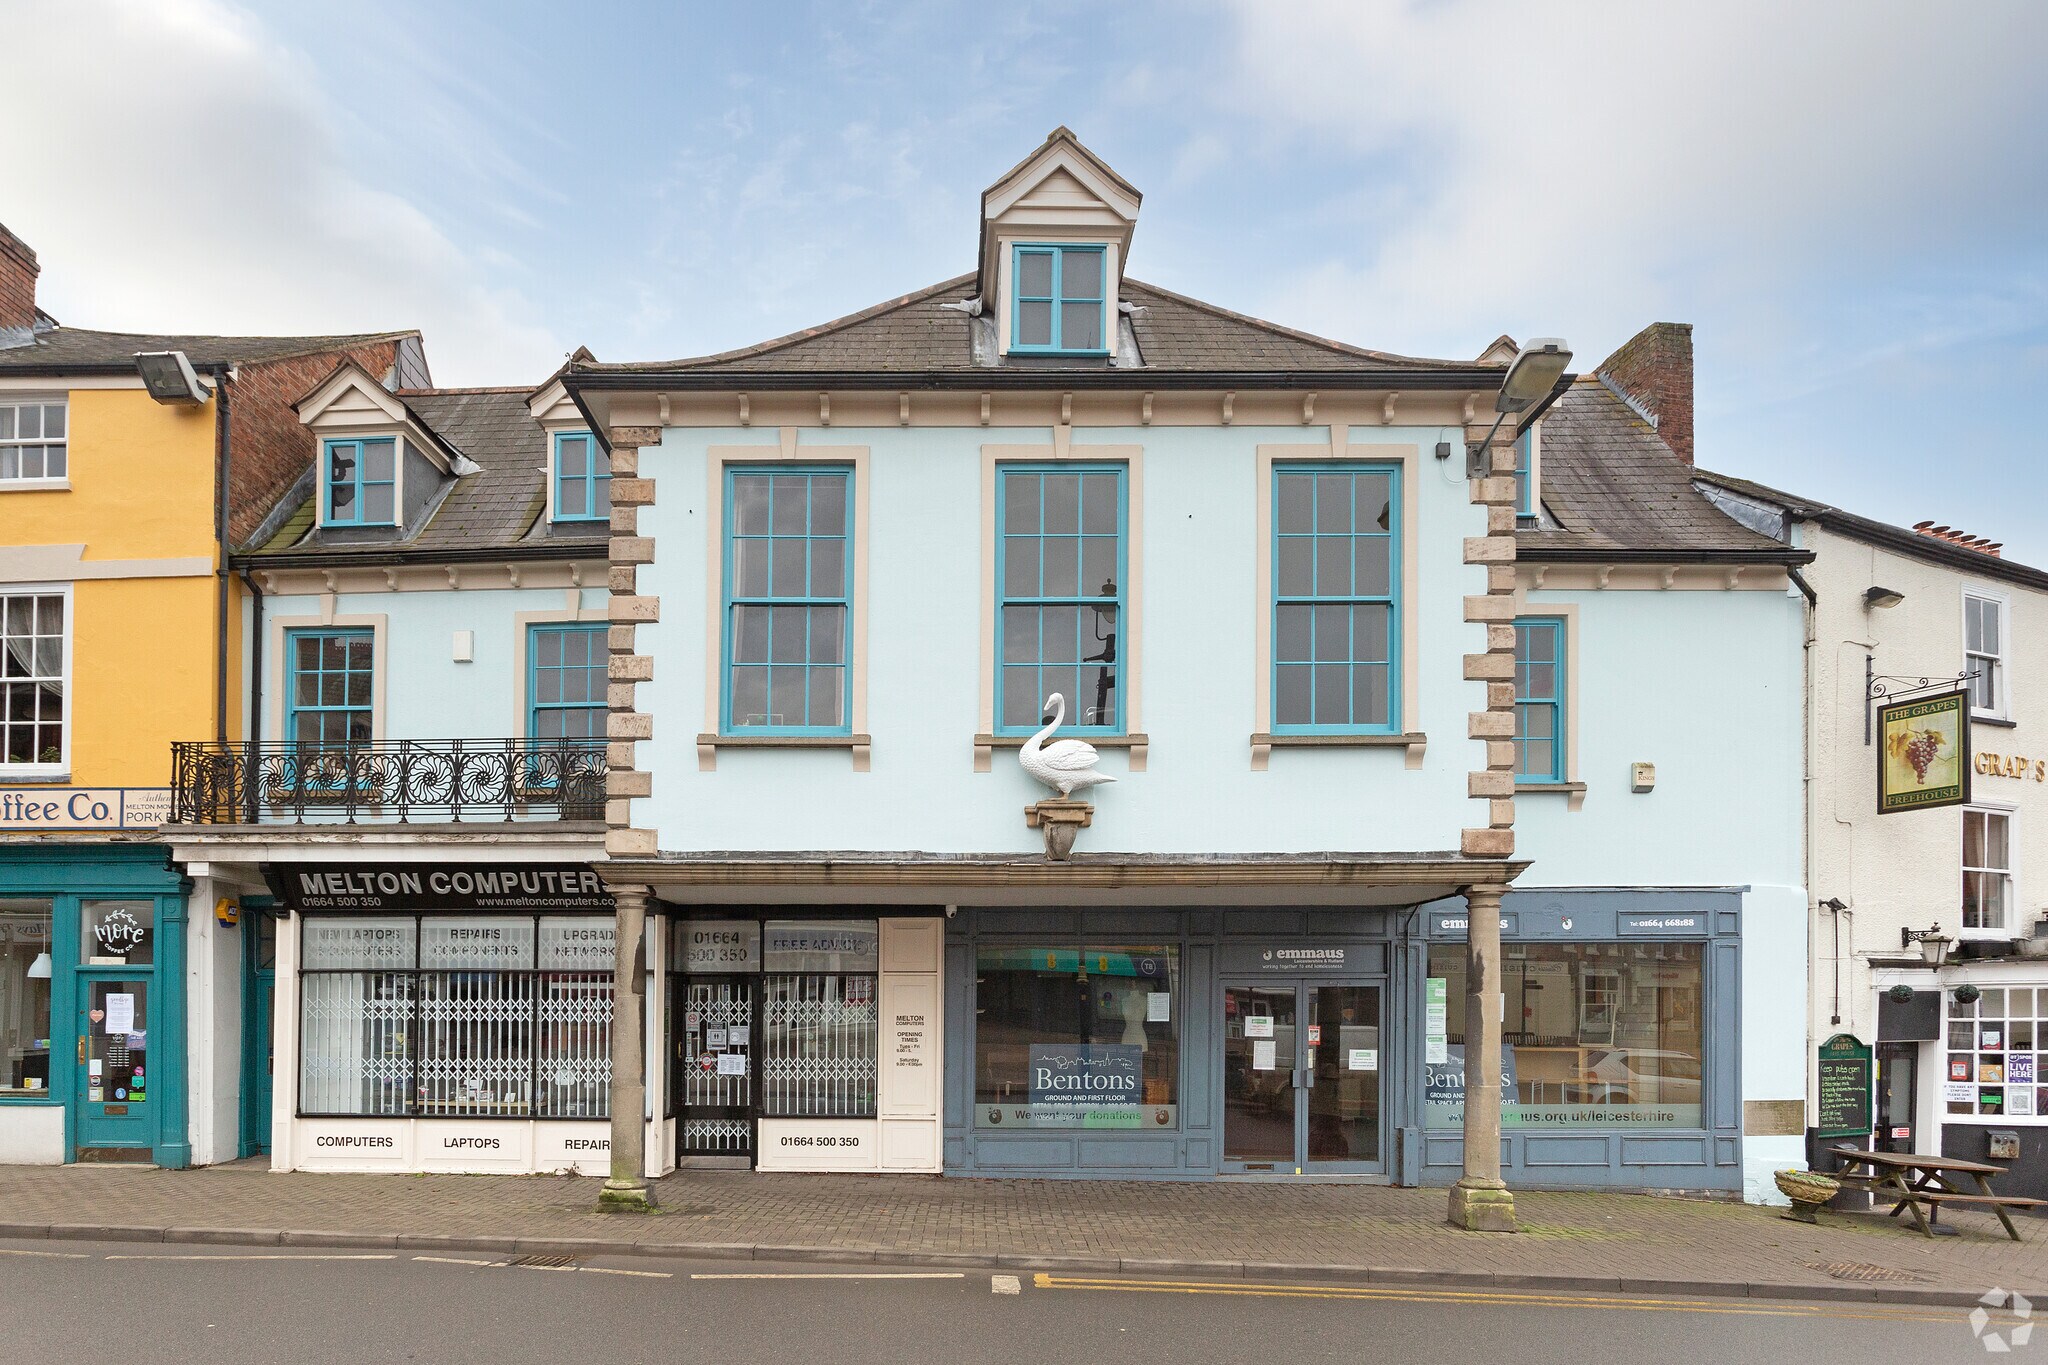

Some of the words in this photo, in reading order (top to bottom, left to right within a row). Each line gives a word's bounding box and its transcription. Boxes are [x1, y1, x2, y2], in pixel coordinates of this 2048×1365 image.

[1887, 708, 1910, 721] THE
[1912, 700, 1957, 716] GRAPES
[1975, 752, 2045, 782] GRAPS
[1888, 787, 1959, 805] FREEHOUSE
[0, 793, 60, 821] offee
[68, 793, 113, 821] Co.
[126, 812, 163, 822] PORK
[300, 872, 423, 894] MELTON
[429, 872, 608, 895] COMPUTER
[302, 897, 334, 906] 01664
[337, 897, 358, 906] 500
[360, 897, 381, 906] 350
[476, 897, 615, 908] www.meltoncomputers.co
[1441, 919, 1509, 929] ems
[1639, 919, 1663, 928] 01664
[1665, 918, 1695, 927] 668188
[319, 929, 343, 940] NEW
[348, 929, 400, 940] LAPTOPS
[450, 928, 501, 939] REPAIRS
[564, 930, 616, 941] UPGRAD
[694, 931, 740, 945] 01664
[104, 942, 124, 954] COFFEE
[555, 946, 615, 957] NETWORK
[719, 949, 748, 962] 350
[1276, 949, 1345, 959] emmaus
[2009, 1062, 2033, 1071] LIVE
[1035, 1067, 1135, 1090] Bentons
[1425, 1065, 1511, 1088] Bents
[2009, 1070, 2033, 1078] HERE
[1015, 1110, 1031, 1120] We
[1089, 1110, 1142, 1120] donations
[316, 1136, 393, 1148] COMPUTERS
[444, 1137, 500, 1149] LAPTOPS
[564, 1139, 611, 1150] REPAIR
[781, 1136, 813, 1147] 01664
[816, 1136, 836, 1147] 500
[839, 1136, 859, 1147] 350
